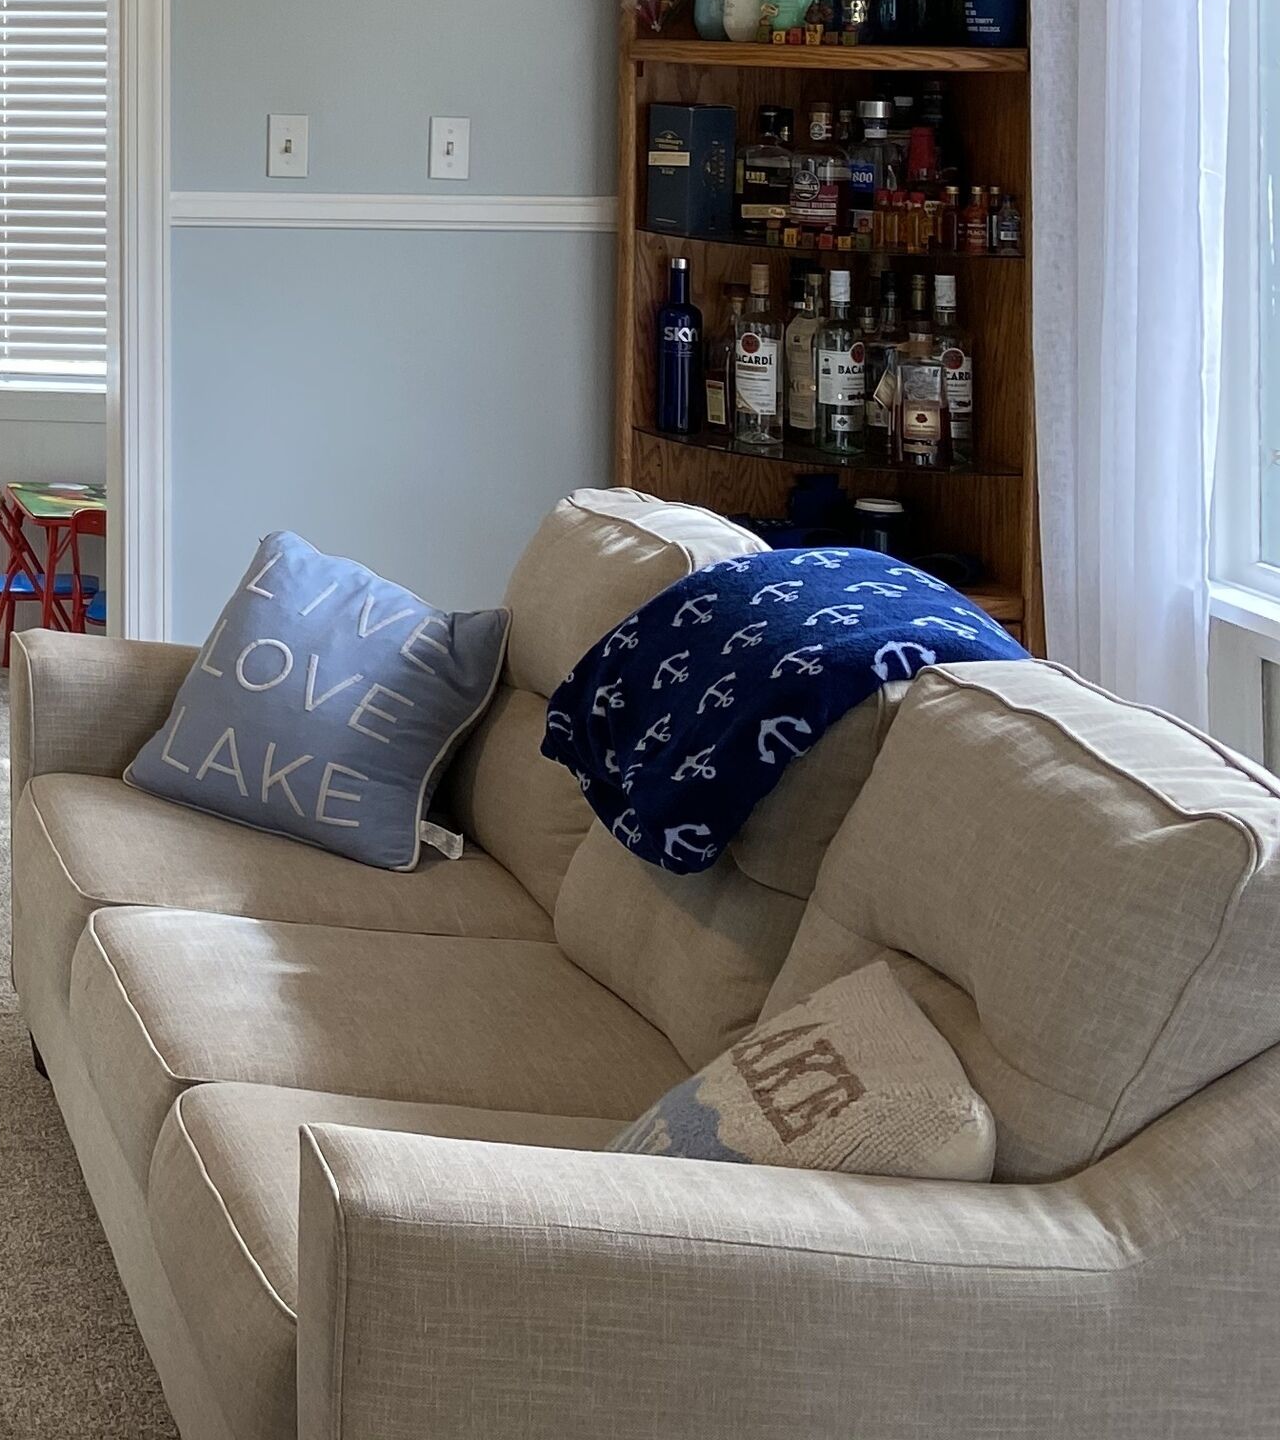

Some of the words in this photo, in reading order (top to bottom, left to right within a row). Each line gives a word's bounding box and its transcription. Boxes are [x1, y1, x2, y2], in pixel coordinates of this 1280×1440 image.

[852, 171, 873, 183] 800
[736, 354, 773, 366] CARDÍ
[838, 365, 865, 375] BACA
[245, 551, 452, 675] LIVE
[201, 618, 415, 744] LOVE
[161, 705, 369, 828] LAKE
[732, 1021, 868, 1146] AKE
